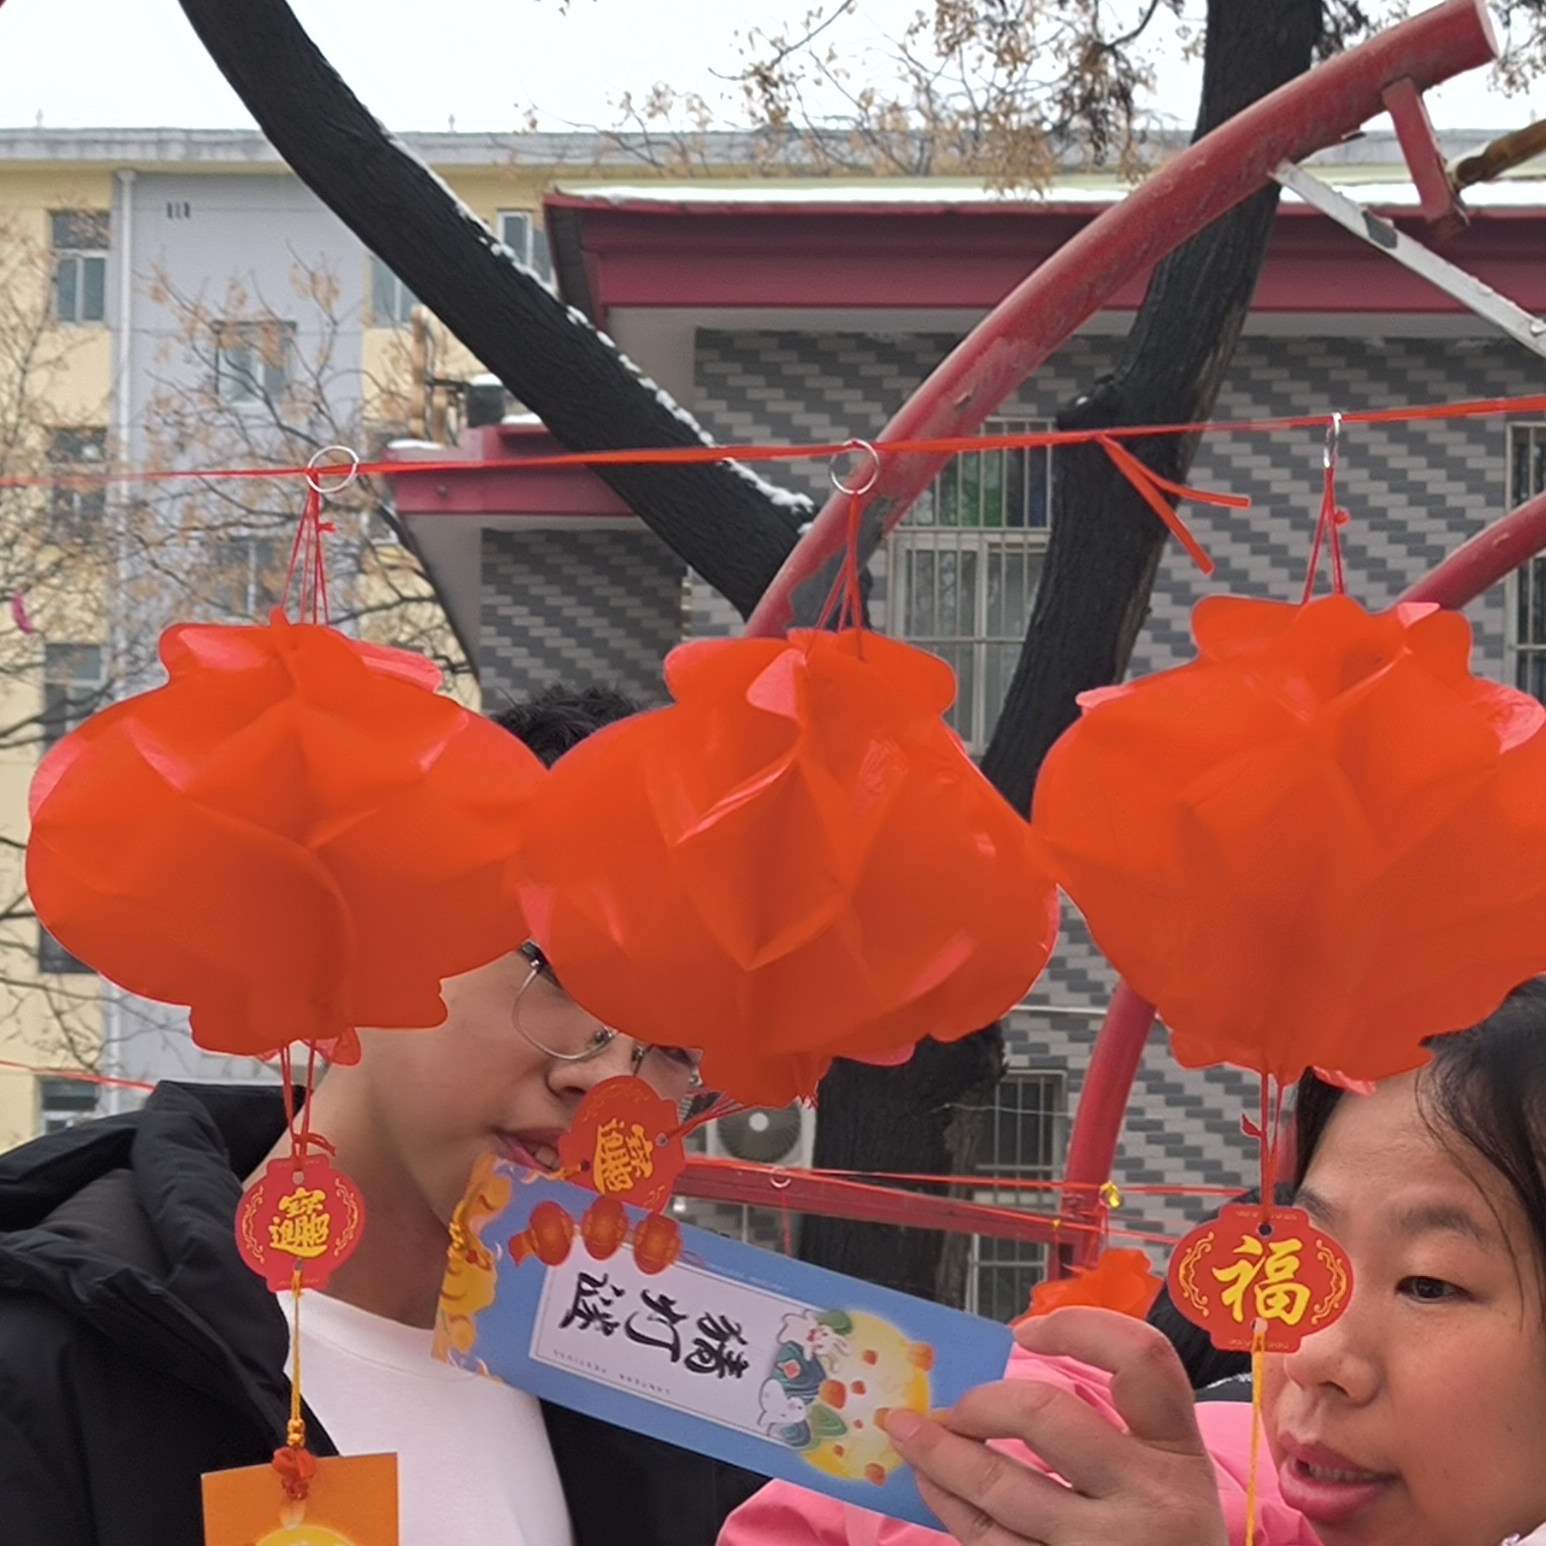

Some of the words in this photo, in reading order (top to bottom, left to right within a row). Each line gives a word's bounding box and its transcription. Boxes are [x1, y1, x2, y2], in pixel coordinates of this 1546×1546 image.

[558, 1271, 750, 1380] 猜灯谜
[1211, 1234, 1311, 1326] 福
